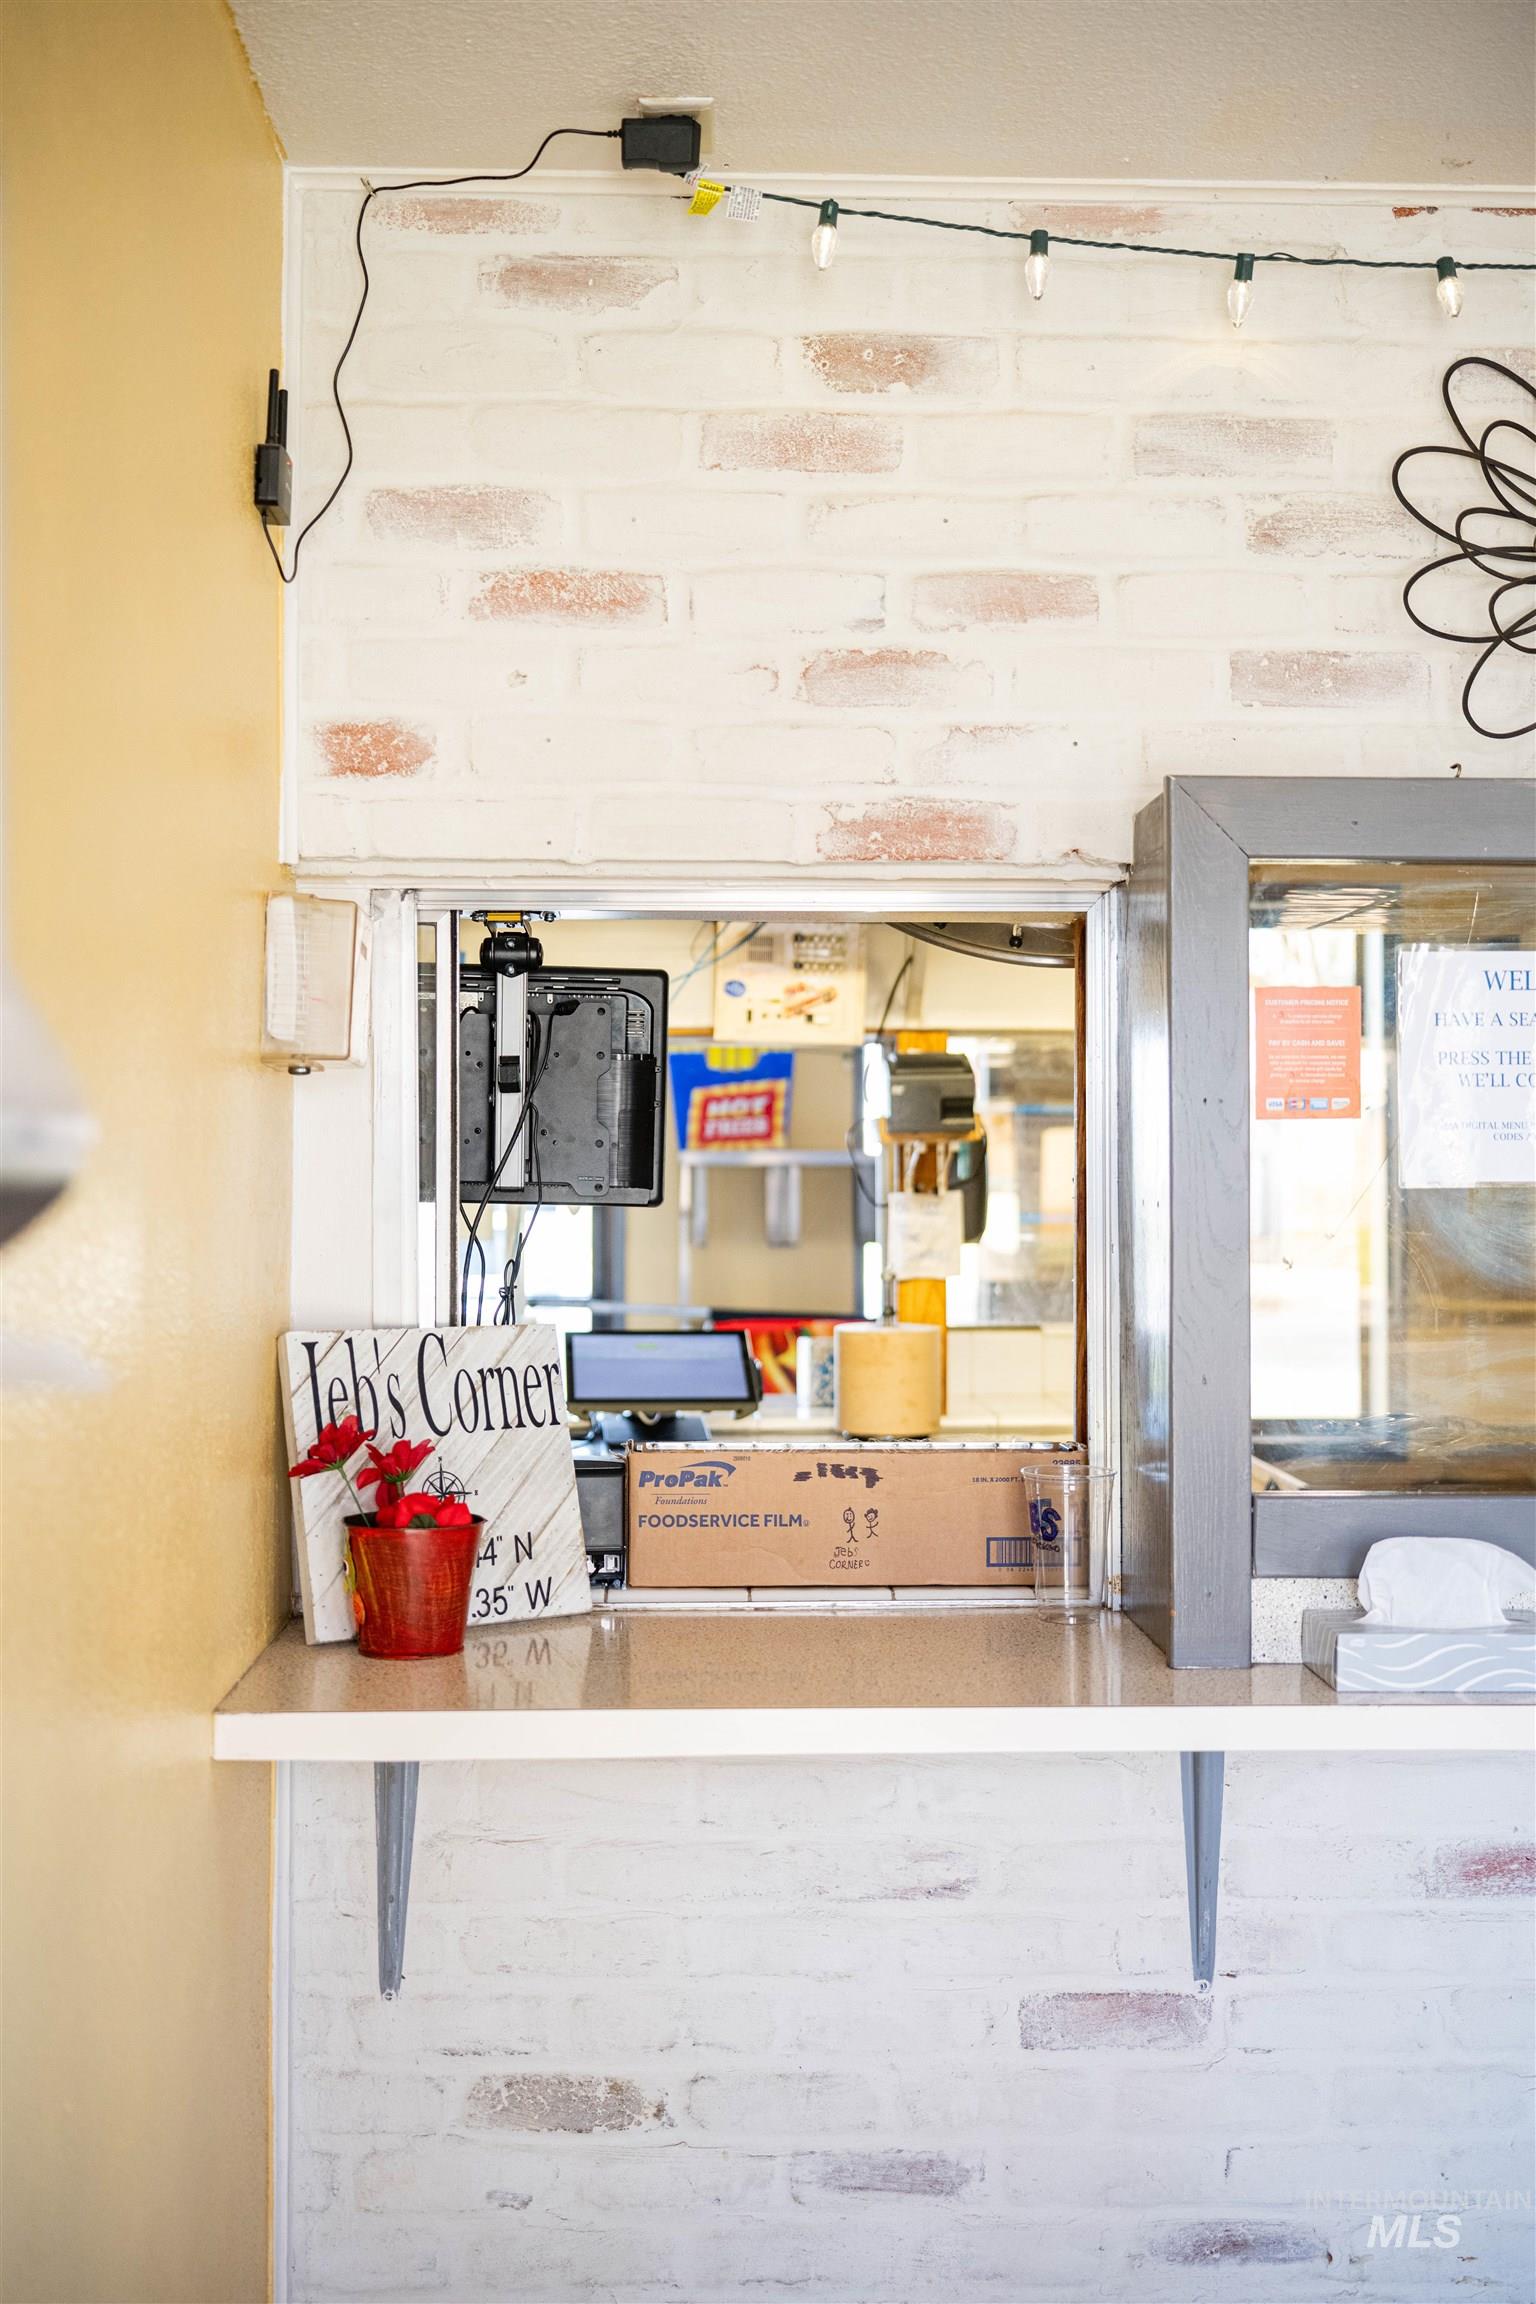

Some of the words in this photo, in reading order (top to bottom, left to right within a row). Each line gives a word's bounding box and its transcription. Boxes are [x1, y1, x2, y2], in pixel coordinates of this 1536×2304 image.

[1435, 1012, 1485, 1026] HAVE
[1491, 1012, 1503, 1026] A
[1438, 1051, 1490, 1065] PRESS
[1495, 1051, 1532, 1065] THE
[1458, 1073, 1511, 1087] WE'LL
[416, 1332, 561, 1438] Corner
[638, 1470, 724, 1488] ProPak
[655, 1496, 708, 1505] Foundations
[638, 1513, 761, 1528] FOODSERVICE
[764, 1513, 803, 1527] FILM
[514, 1531, 533, 1563] N
[829, 1559, 864, 1570] CORNER
[525, 1576, 552, 1610] W
